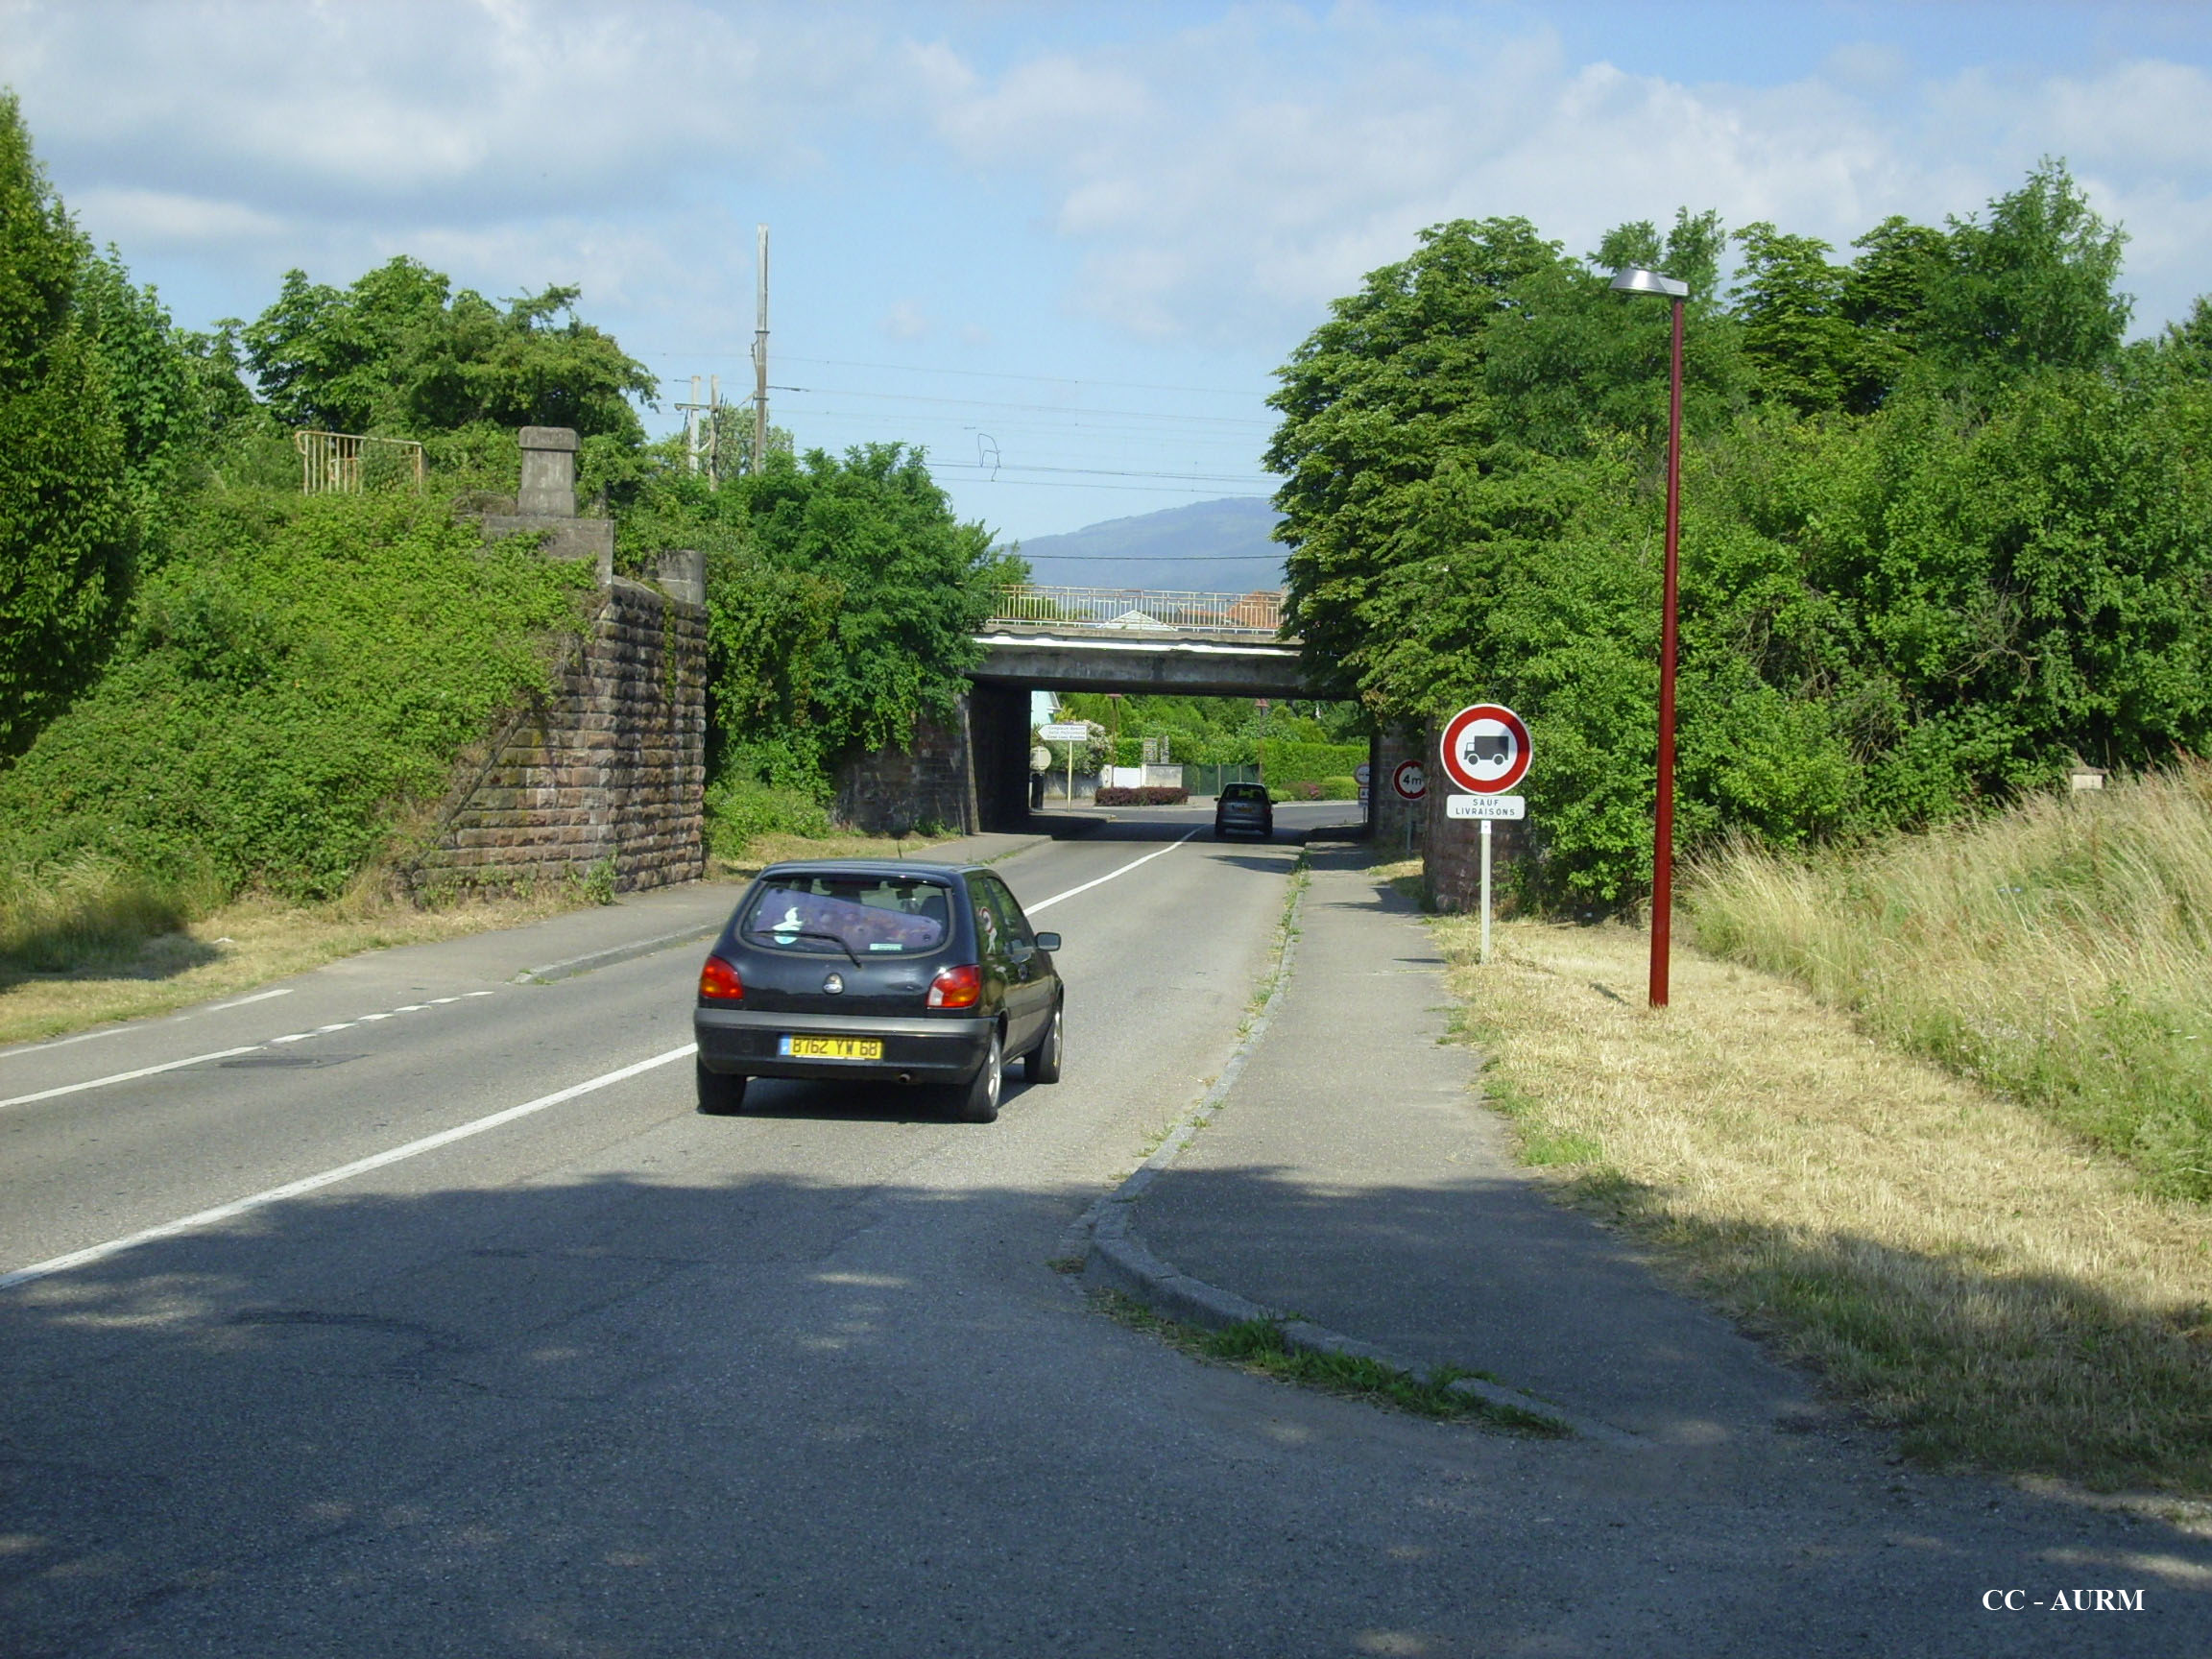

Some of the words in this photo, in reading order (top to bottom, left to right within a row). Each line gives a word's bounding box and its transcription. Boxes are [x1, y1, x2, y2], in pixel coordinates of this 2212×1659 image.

[1473, 798, 1499, 806] SAUF
[1455, 807, 1515, 816] LIVRAISONS
[859, 1040, 878, 1057] 68
